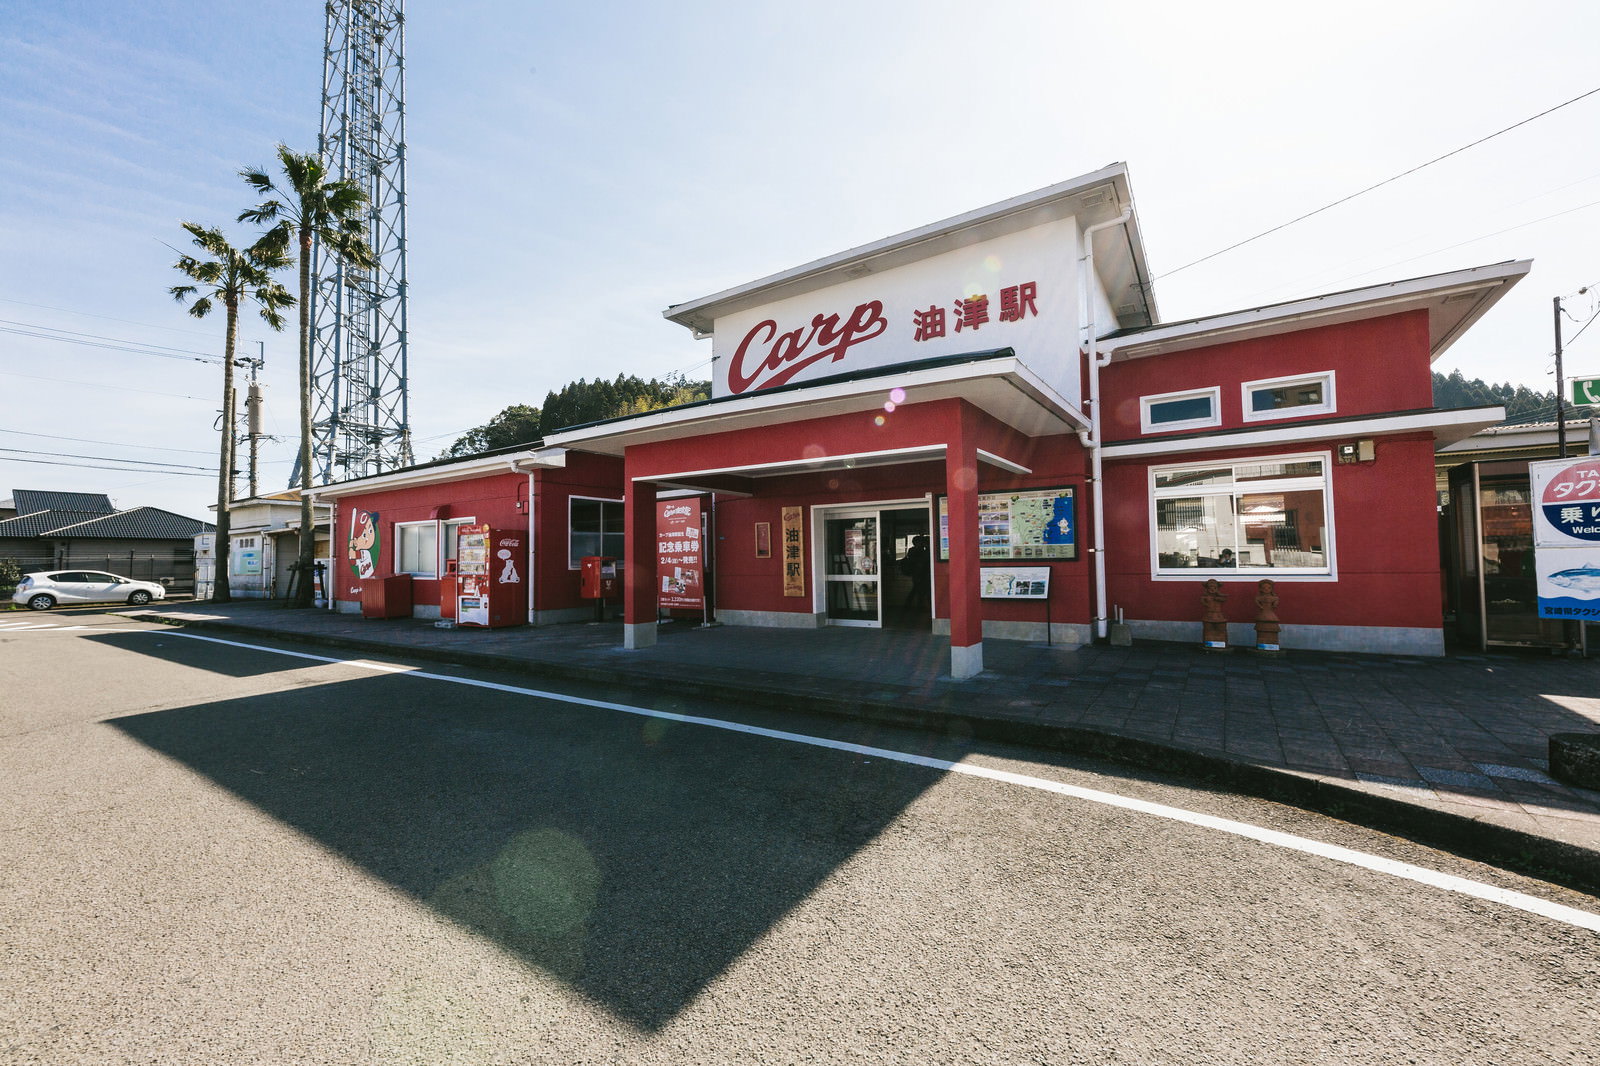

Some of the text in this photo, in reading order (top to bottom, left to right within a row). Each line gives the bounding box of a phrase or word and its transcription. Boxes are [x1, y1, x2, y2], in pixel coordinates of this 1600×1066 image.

[912, 281, 1038, 343] 油津駅
[728, 300, 887, 395] Carp
[1553, 480, 1600, 498] タク
[1576, 470, 1600, 479] TA
[658, 540, 699, 553] 記念乗車券
[785, 527, 801, 577] 油津駅
